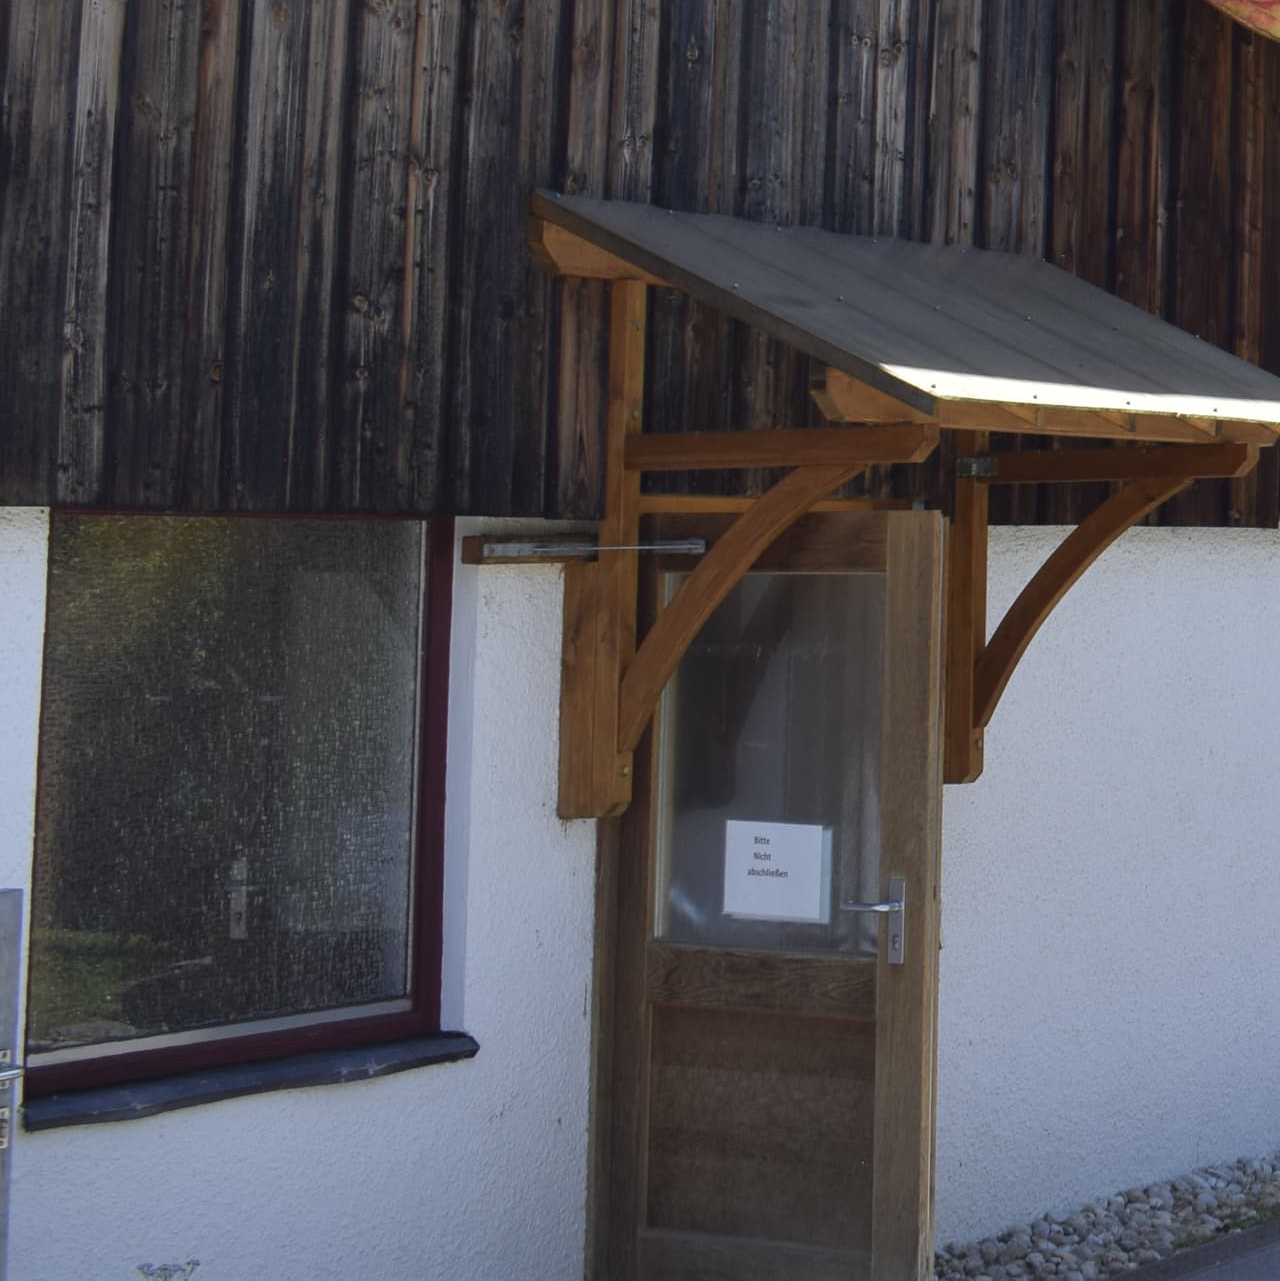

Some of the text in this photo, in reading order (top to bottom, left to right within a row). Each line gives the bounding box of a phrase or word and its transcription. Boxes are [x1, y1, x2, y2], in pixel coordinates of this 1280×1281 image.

[754, 836, 770, 845] Bitte
[753, 852, 771, 861] Nicht
[747, 867, 788, 879] abschließen
